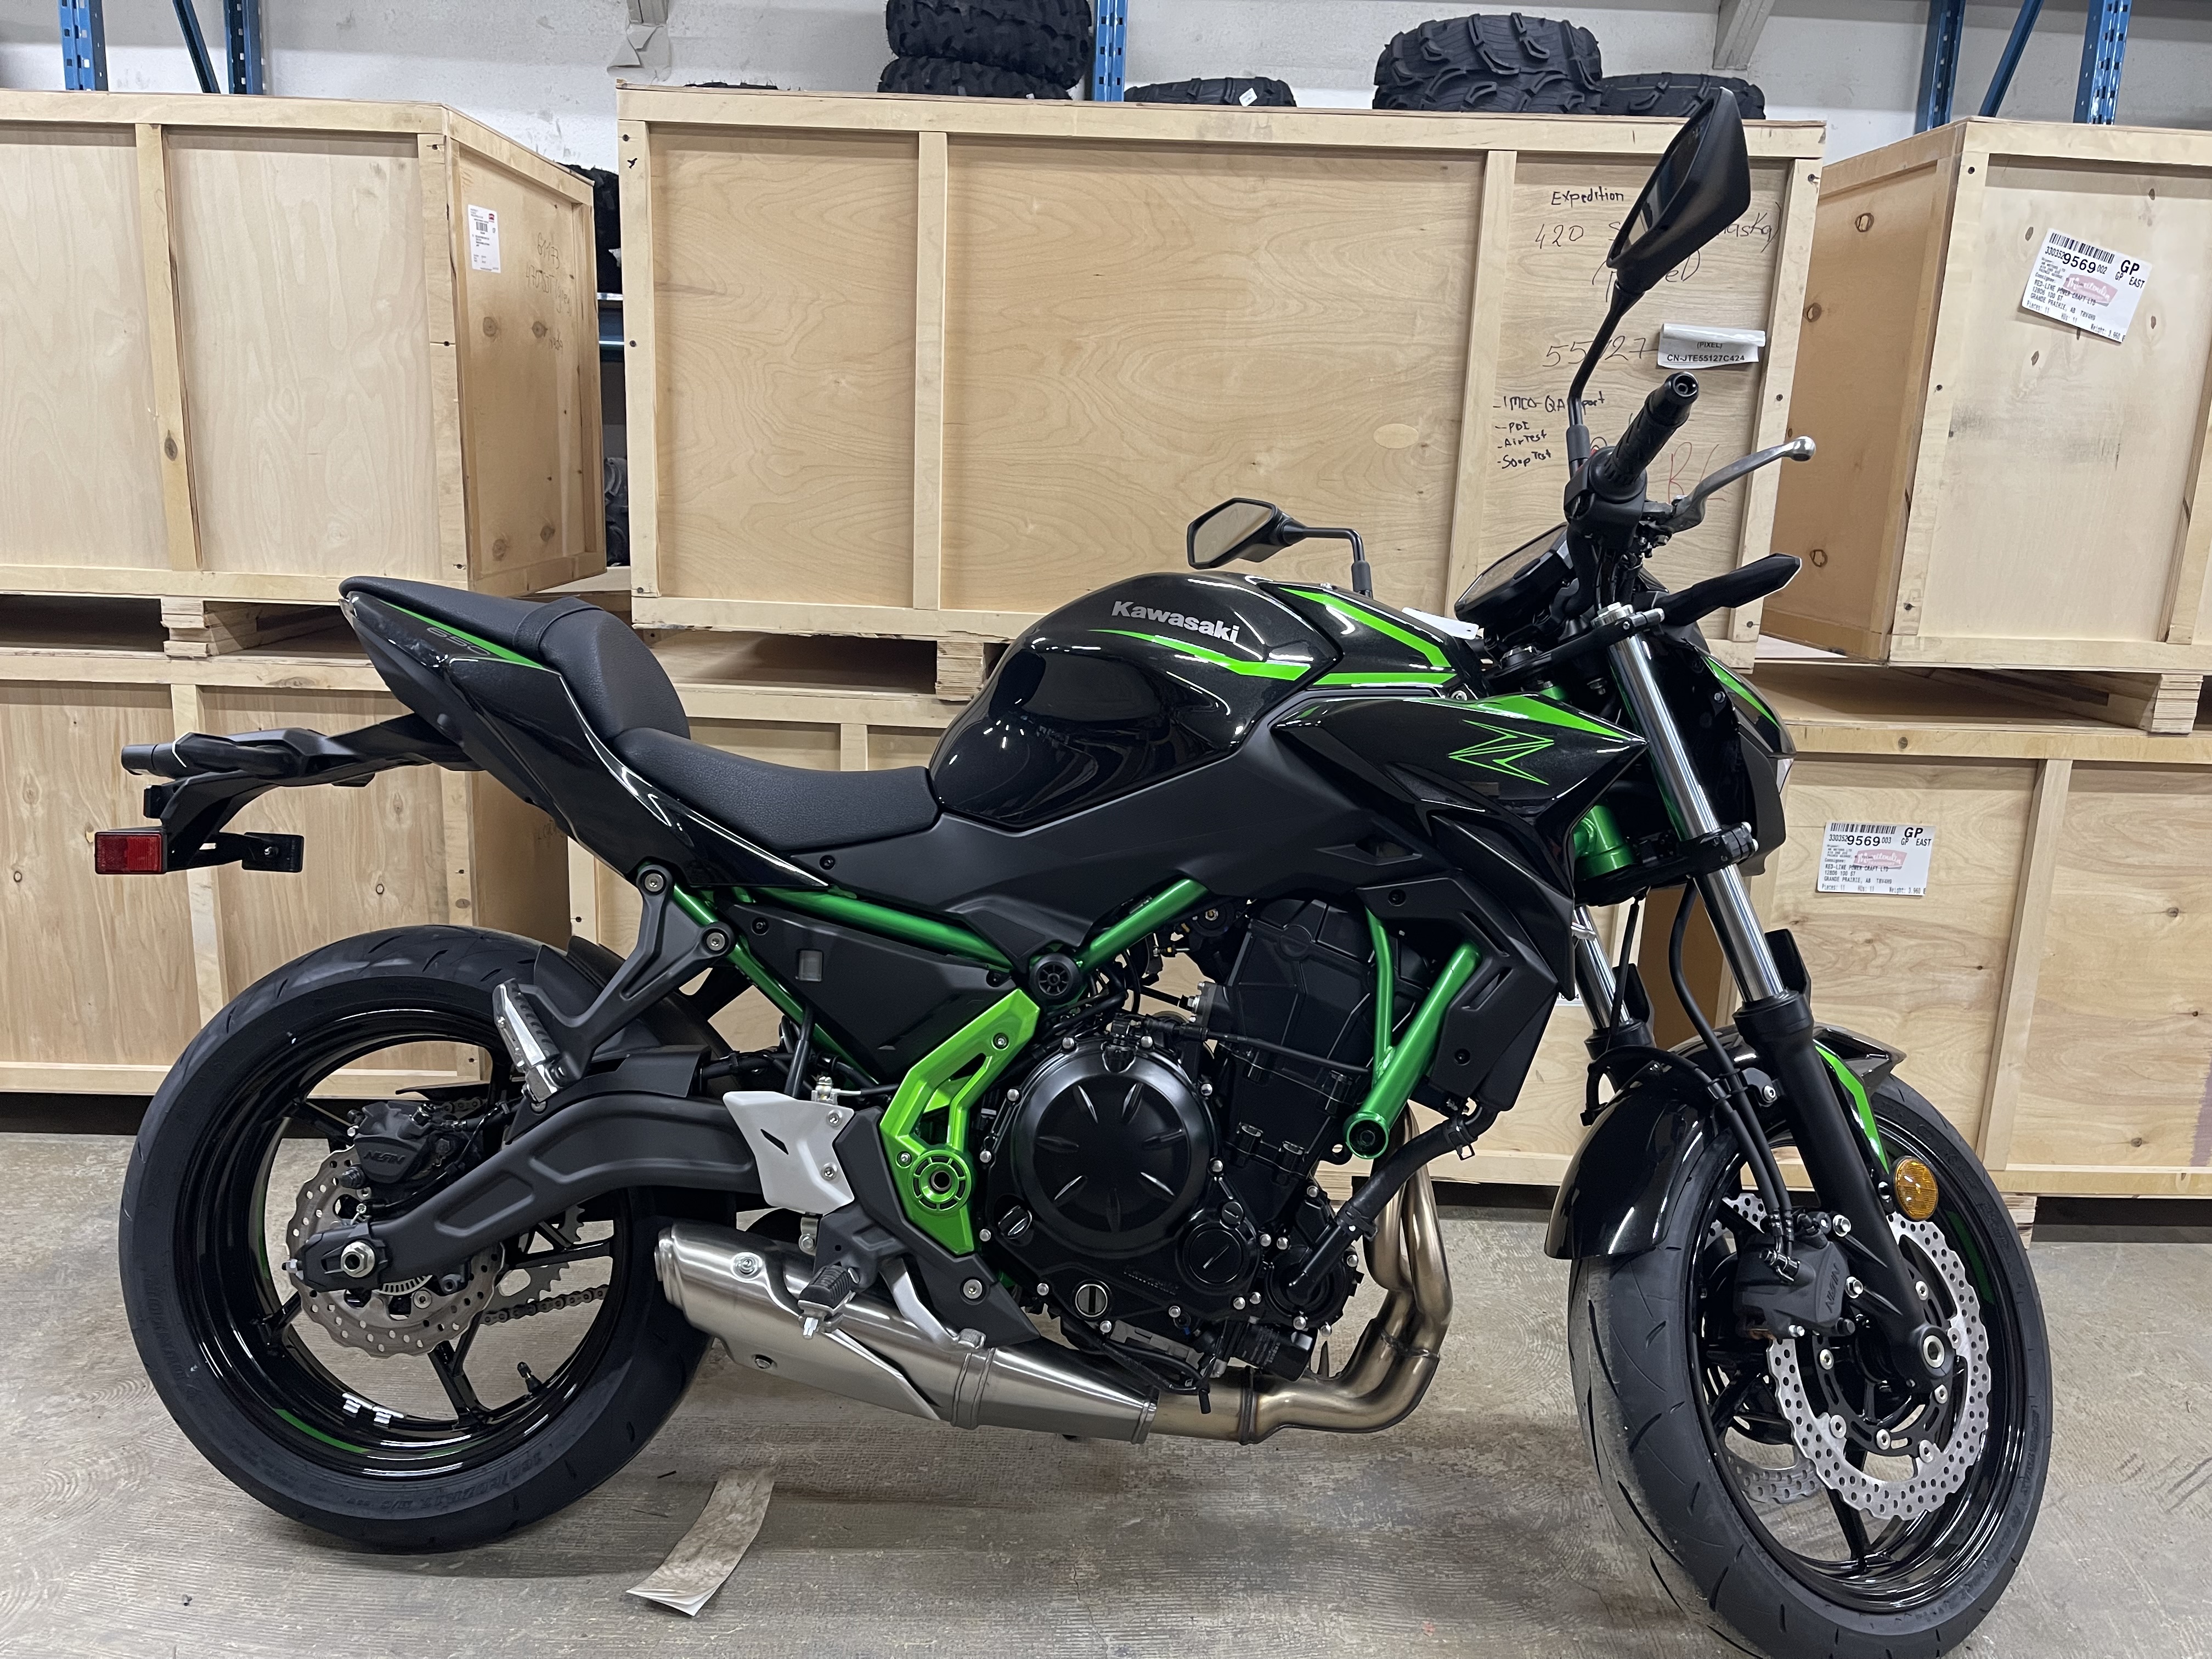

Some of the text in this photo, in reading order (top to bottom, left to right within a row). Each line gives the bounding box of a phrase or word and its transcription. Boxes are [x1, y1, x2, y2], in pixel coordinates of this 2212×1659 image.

[1550, 185, 1624, 208] Expedition
[1535, 224, 1584, 250] 420
[2120, 259, 2140, 275] GP
[2115, 272, 2145, 289] GP EAST
[1111, 601, 1240, 642] Kawasaki
[426, 627, 491, 656] 650
[1904, 827, 1923, 838] GP
